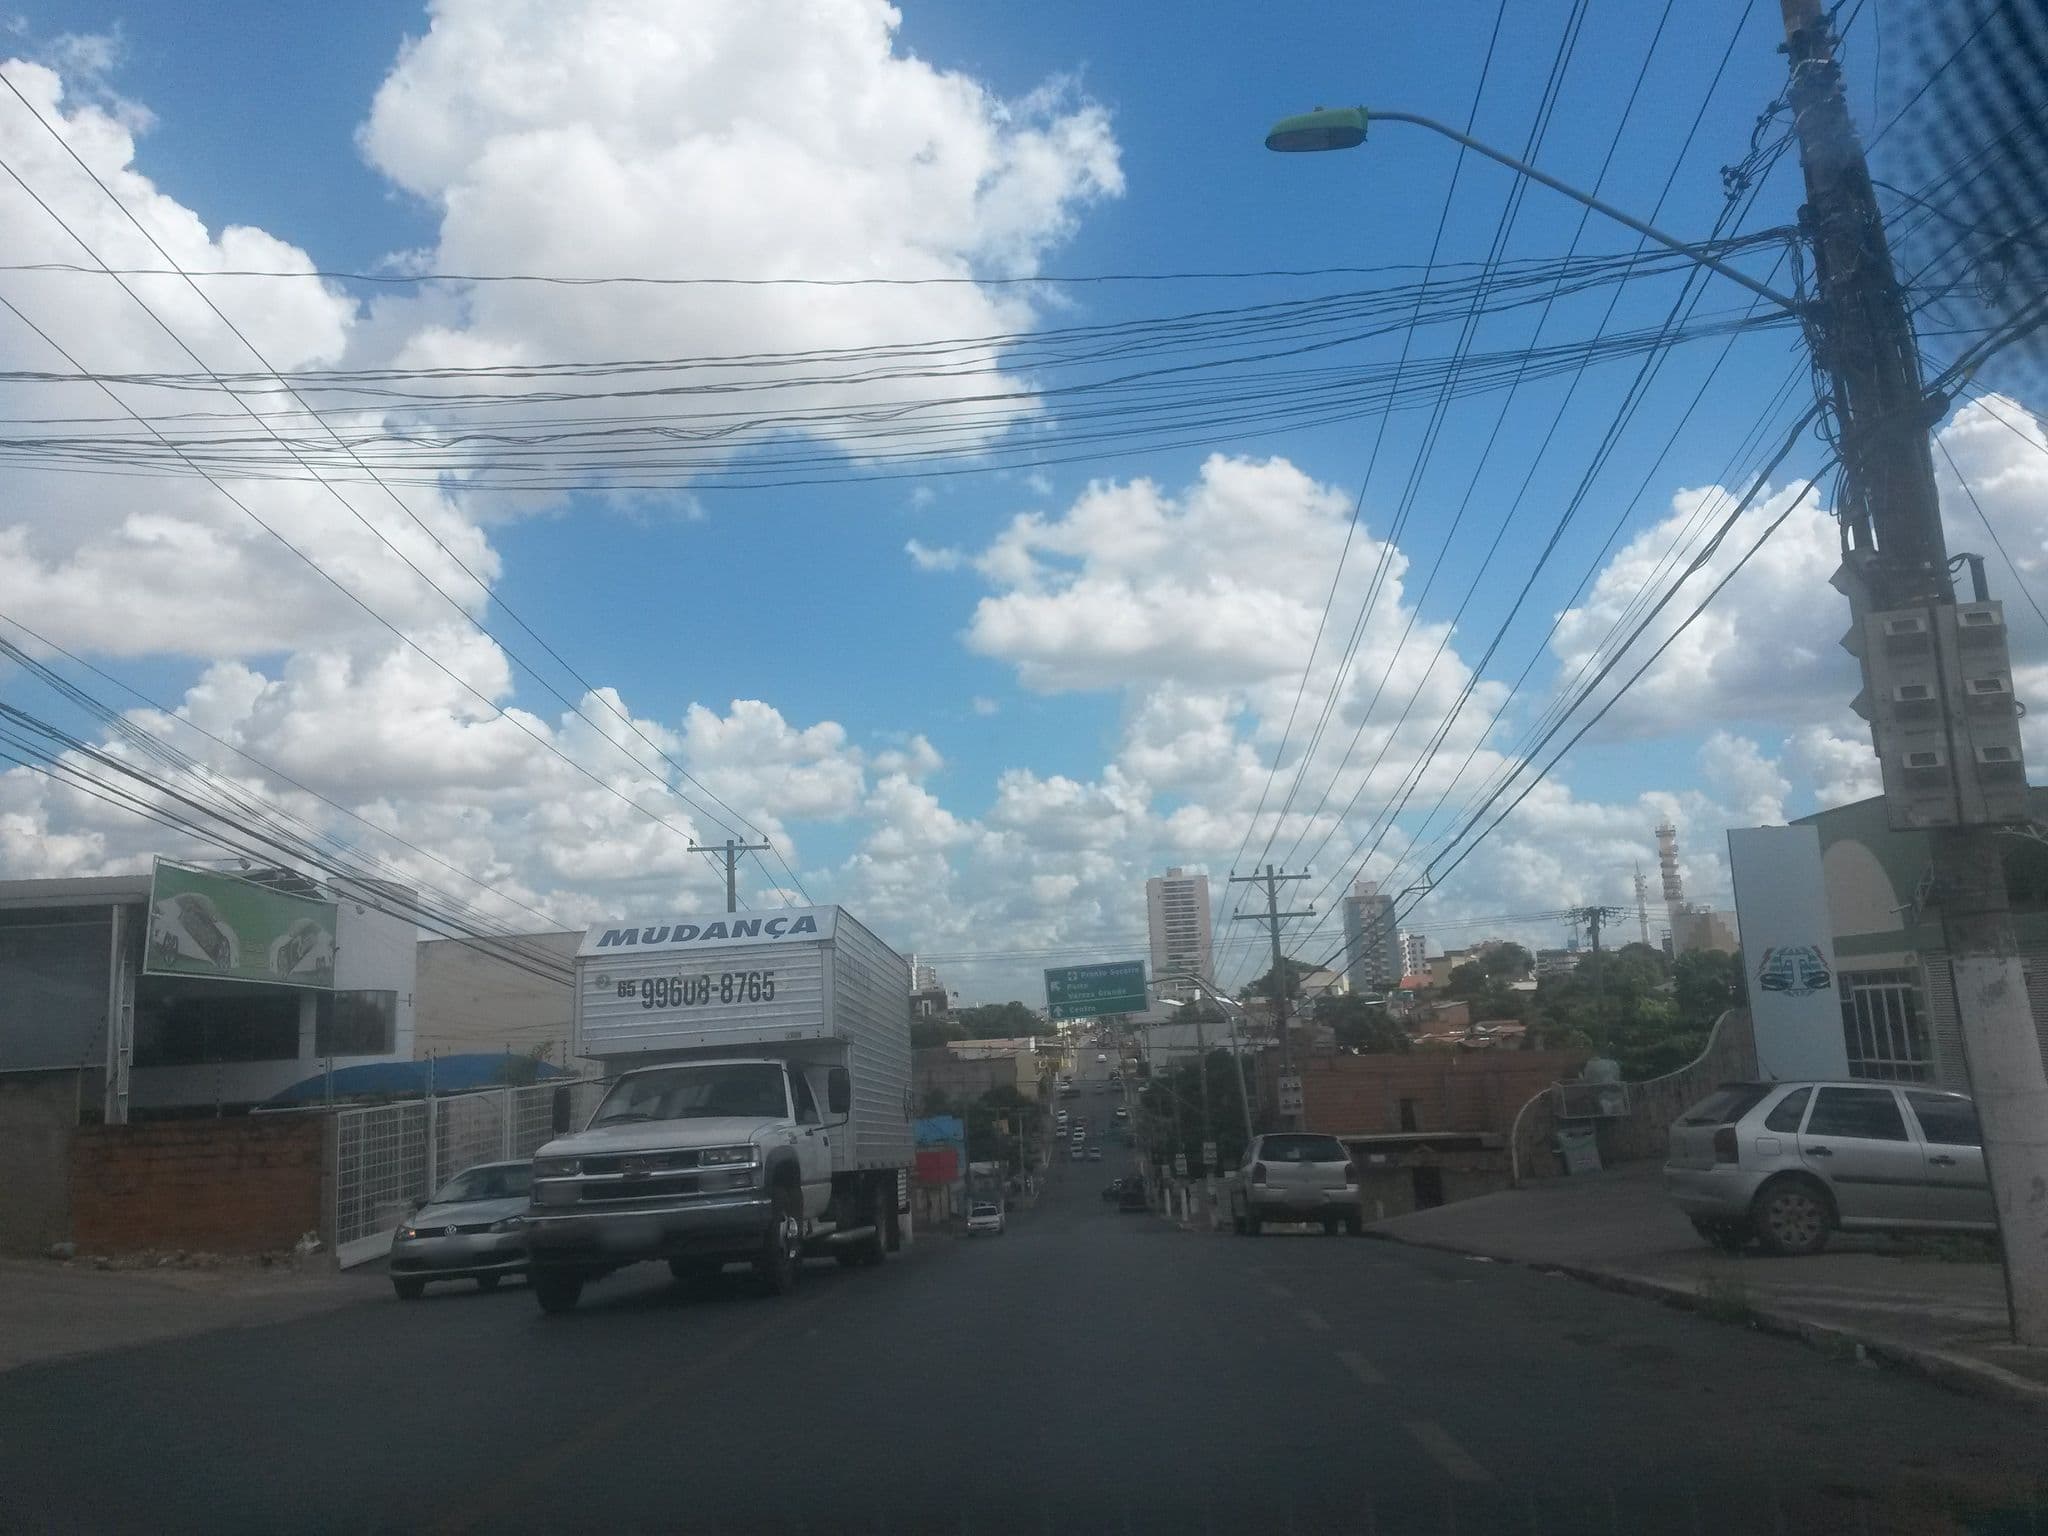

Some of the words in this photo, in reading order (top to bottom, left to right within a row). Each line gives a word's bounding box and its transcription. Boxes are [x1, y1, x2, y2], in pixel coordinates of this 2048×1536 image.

[597, 915, 817, 947] MUDANÇA
[642, 971, 775, 1009] 99608-8765
[1070, 1005, 1096, 1013] Centro
